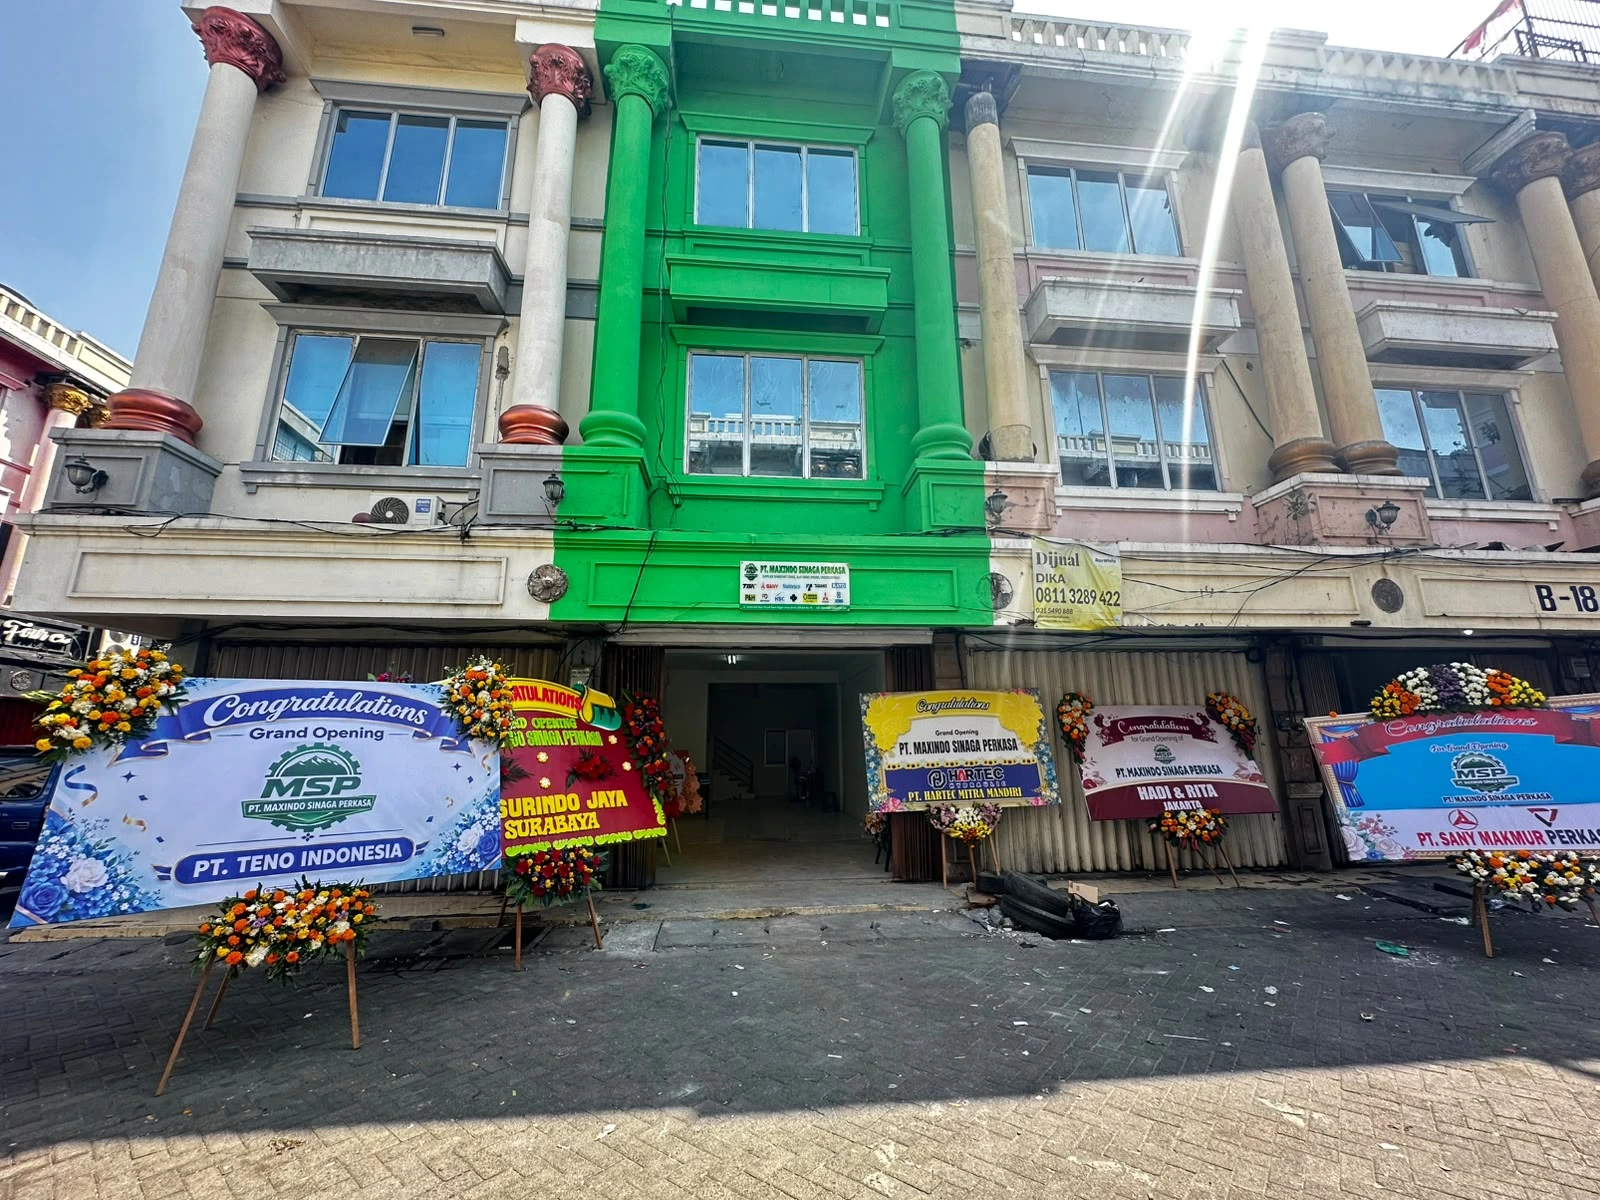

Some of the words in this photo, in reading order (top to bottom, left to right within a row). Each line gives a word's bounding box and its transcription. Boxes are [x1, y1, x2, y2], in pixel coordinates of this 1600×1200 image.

[1036, 551, 1080, 568] Dijual
[760, 565, 768, 574] PT.
[770, 565, 797, 574] MAXINDO
[798, 566, 820, 574] SINAGA
[820, 566, 846, 574] PERKASA
[1036, 573, 1066, 584] DIKA
[1036, 587, 1066, 603] 0811
[1069, 588, 1096, 605] 3289
[1099, 590, 1120, 606] 422
[1534, 585, 1598, 612] B-18
[204, 691, 428, 727] Congratulations
[916, 697, 990, 714] Congratulations
[532, 717, 577, 729] OPENING
[1118, 720, 1190, 734] Congratulations
[1384, 714, 1538, 738] Congratulations
[249, 727, 310, 740] Grand
[312, 726, 384, 742] Opening
[526, 730, 564, 746] SINAGA
[563, 730, 603, 746] PERKASA
[900, 743, 912, 755] PT.
[914, 740, 950, 754] MAXINDO
[952, 740, 981, 753] SINAGA
[983, 738, 1018, 752] PERKASA
[1471, 742, 1508, 750] Opening
[949, 767, 1004, 782] HARTEC
[1116, 768, 1128, 778] PT.
[1128, 767, 1161, 777] MAXINDO
[1162, 766, 1189, 776] SINAGA
[1190, 764, 1222, 775] PERKASA
[1456, 768, 1508, 779] MSP
[261, 775, 361, 798] MSP
[908, 791, 922, 801] PT.
[924, 789, 956, 800] HARTEC
[958, 788, 984, 800] MITRA
[987, 787, 1022, 798] MANDIRI
[1137, 786, 1171, 800] HADI
[1174, 786, 1185, 799] &
[1186, 784, 1218, 798] RITA
[248, 803, 262, 813] PT.
[263, 801, 306, 812] MAXINDO
[307, 800, 337, 811] SINAGA
[338, 798, 372, 810] PERKASA
[586, 790, 628, 809] JAYA
[1163, 800, 1203, 811] JAKARTA
[1443, 795, 1454, 804] PT.
[1454, 794, 1487, 803] MAXINDO
[1488, 793, 1514, 802] SINAGA
[1516, 792, 1552, 801] PERKASA
[504, 812, 600, 840] SURABAYA
[1416, 832, 1437, 847] PT.
[1440, 831, 1476, 846] SANY
[1479, 830, 1546, 846] MAKMUR
[193, 856, 227, 878] PT.
[237, 850, 296, 874] TENO
[301, 842, 402, 868] INDONESIA
